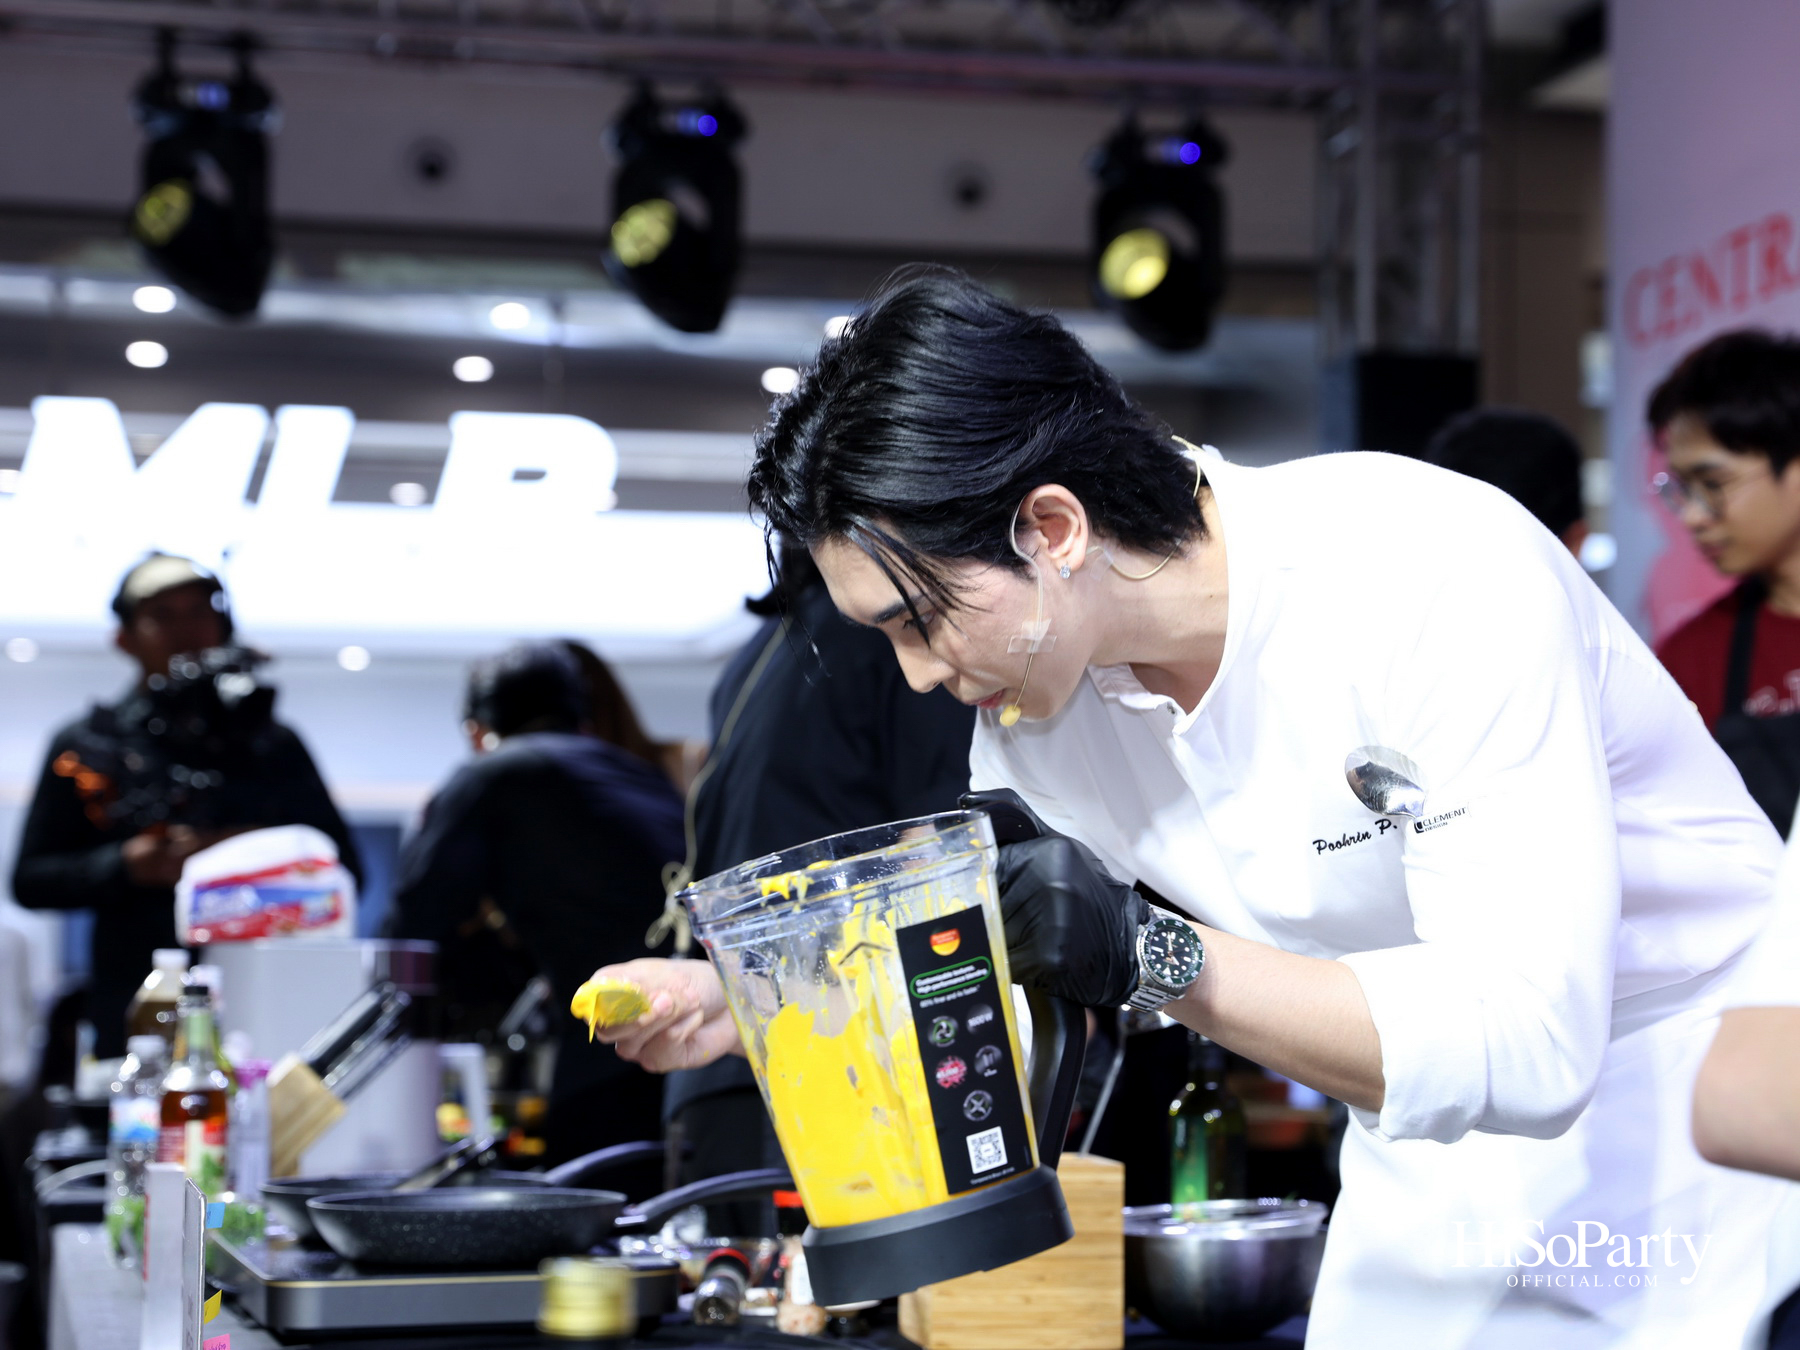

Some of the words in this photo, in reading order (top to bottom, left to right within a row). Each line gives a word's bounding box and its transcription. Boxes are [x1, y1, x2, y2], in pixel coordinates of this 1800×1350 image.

[1624, 213, 1800, 348] CENTR
[1374, 818, 1398, 835] P.
[1423, 807, 1467, 827] CLEMENT
